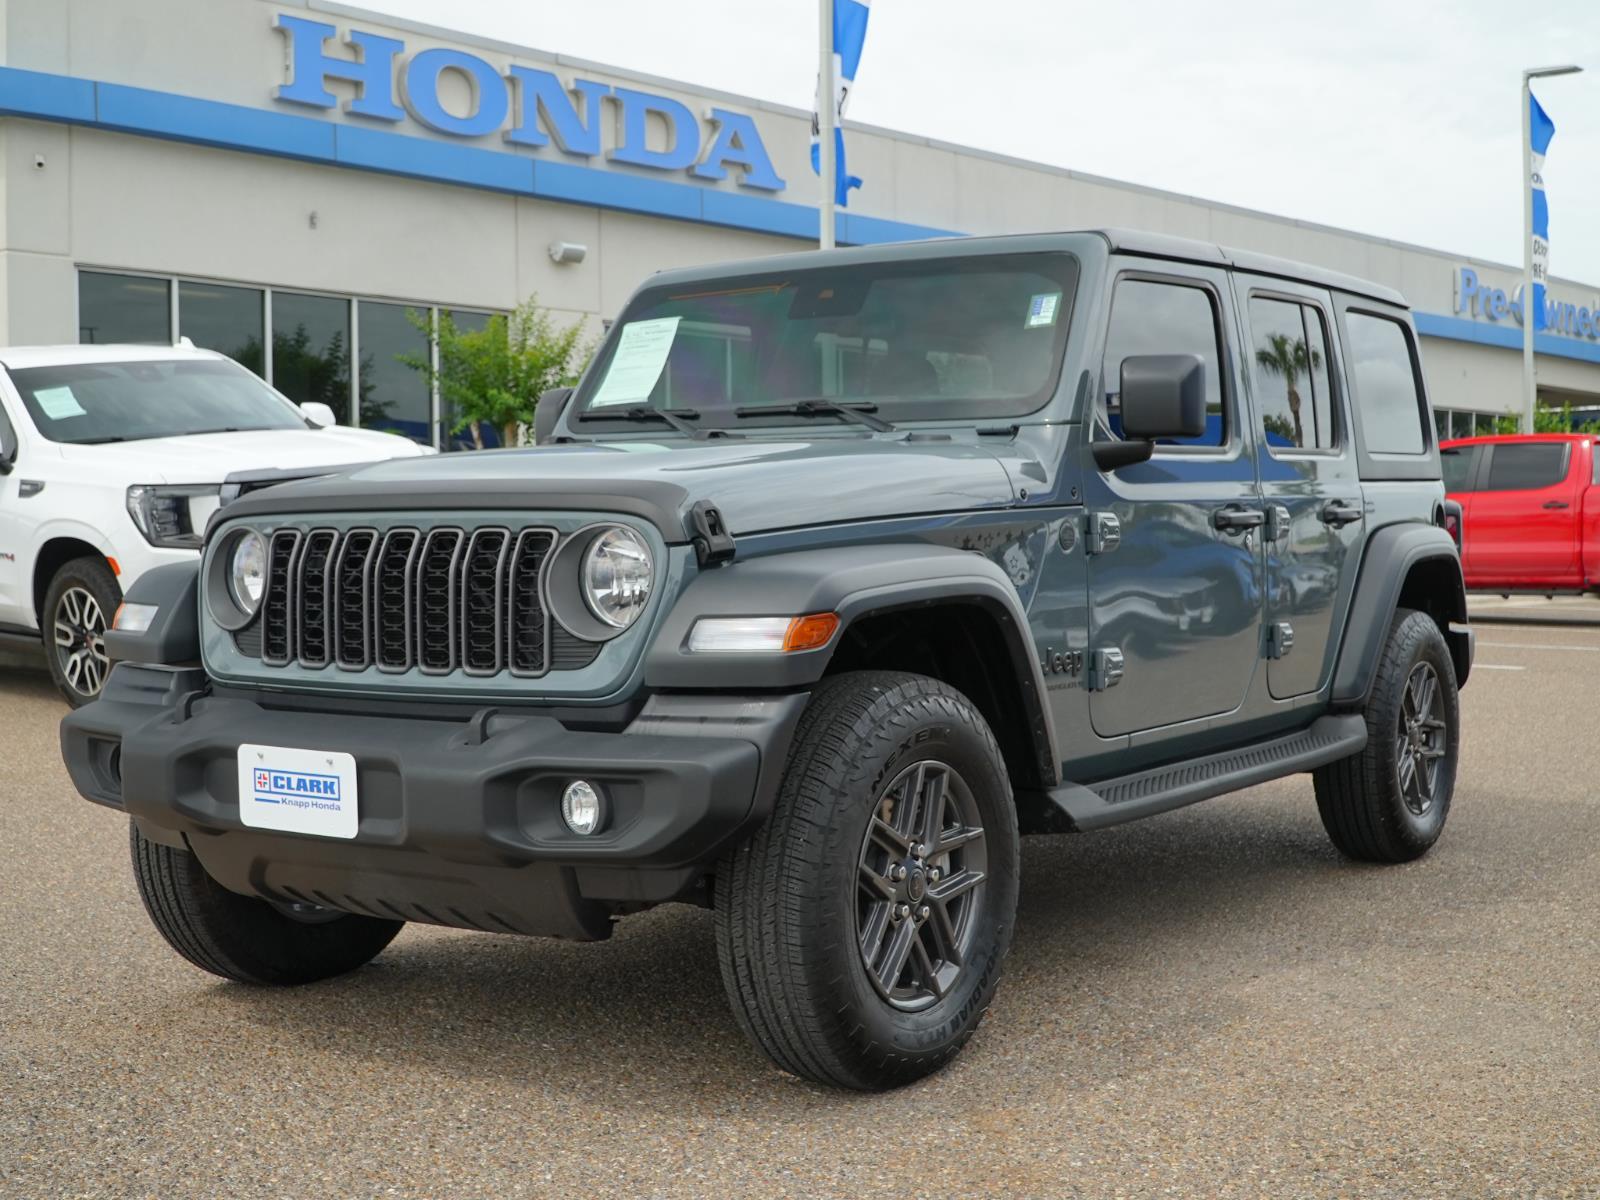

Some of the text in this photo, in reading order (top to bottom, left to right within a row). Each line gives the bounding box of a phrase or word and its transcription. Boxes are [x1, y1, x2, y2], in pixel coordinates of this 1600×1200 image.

[272, 14, 785, 192] HONDA
[1459, 267, 1600, 338] Pre-wne
[1040, 647, 1083, 677] Jeep
[273, 775, 336, 795] CLARK
[281, 797, 341, 812] Knapp Honda
